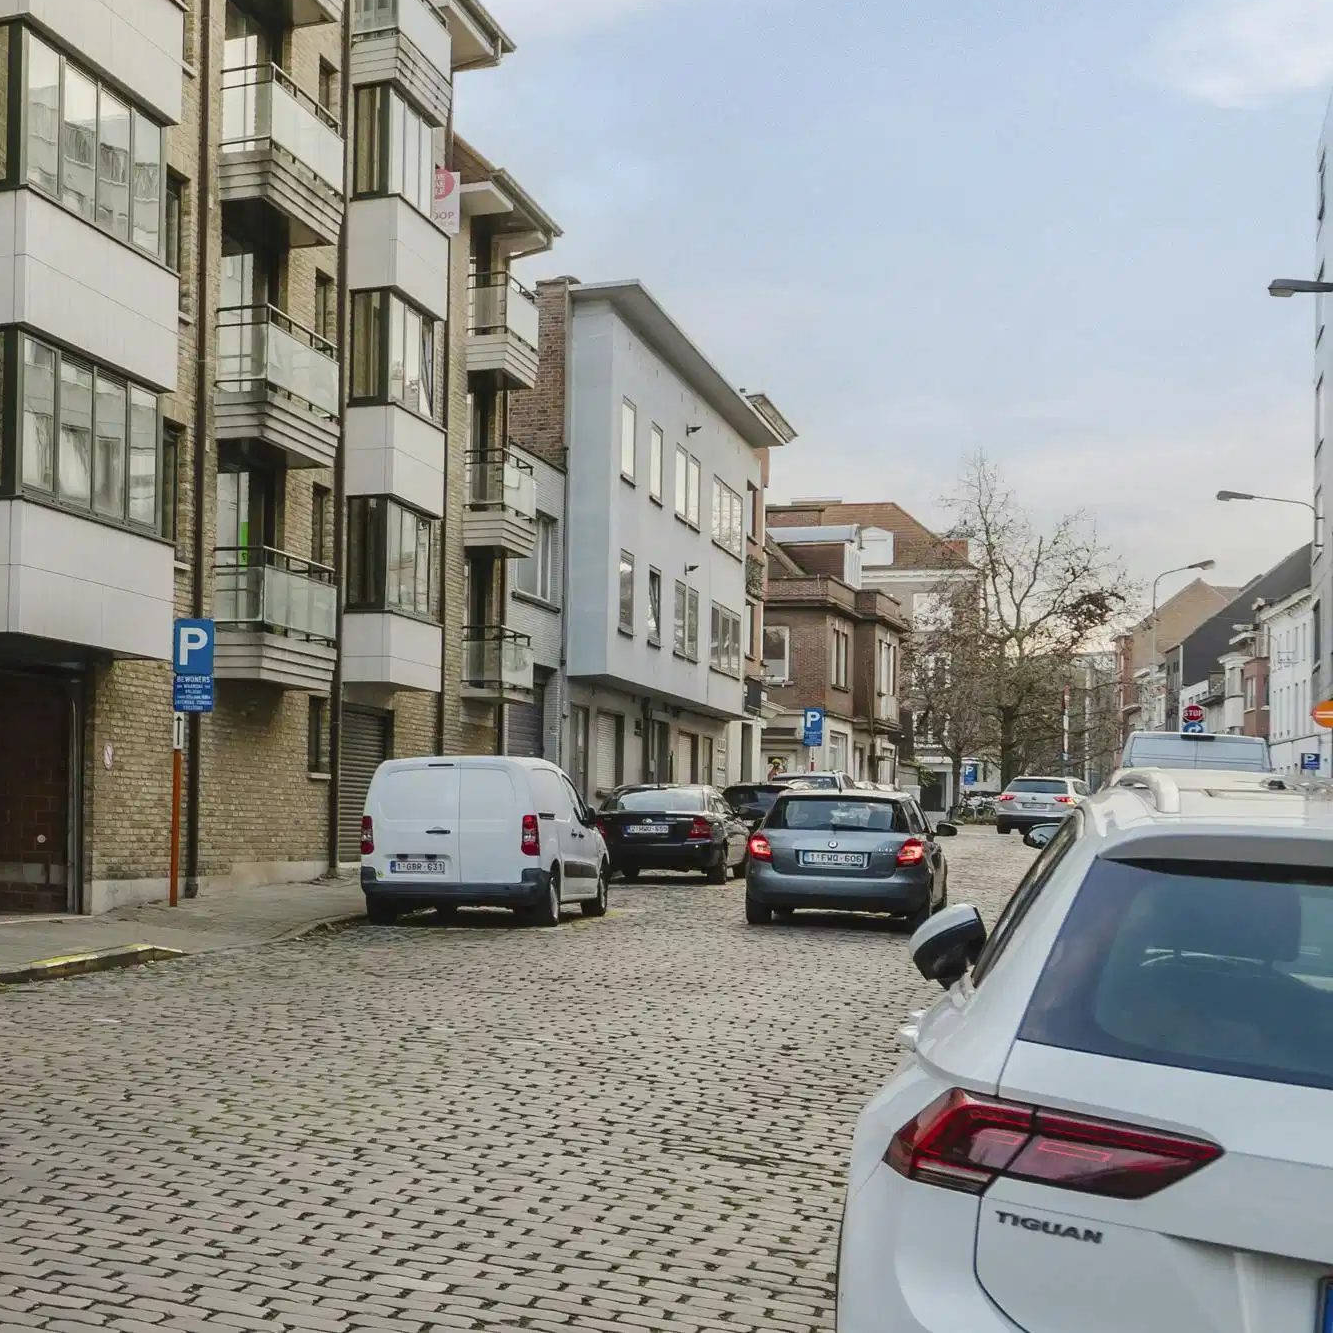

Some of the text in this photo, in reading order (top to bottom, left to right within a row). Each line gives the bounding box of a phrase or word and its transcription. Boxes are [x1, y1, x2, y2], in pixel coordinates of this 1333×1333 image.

[179, 627, 209, 666] P
[806, 711, 821, 728] P
[1183, 709, 1203, 717] STOP
[965, 765, 974, 776] P
[994, 1209, 1103, 1245] TIGUAN
